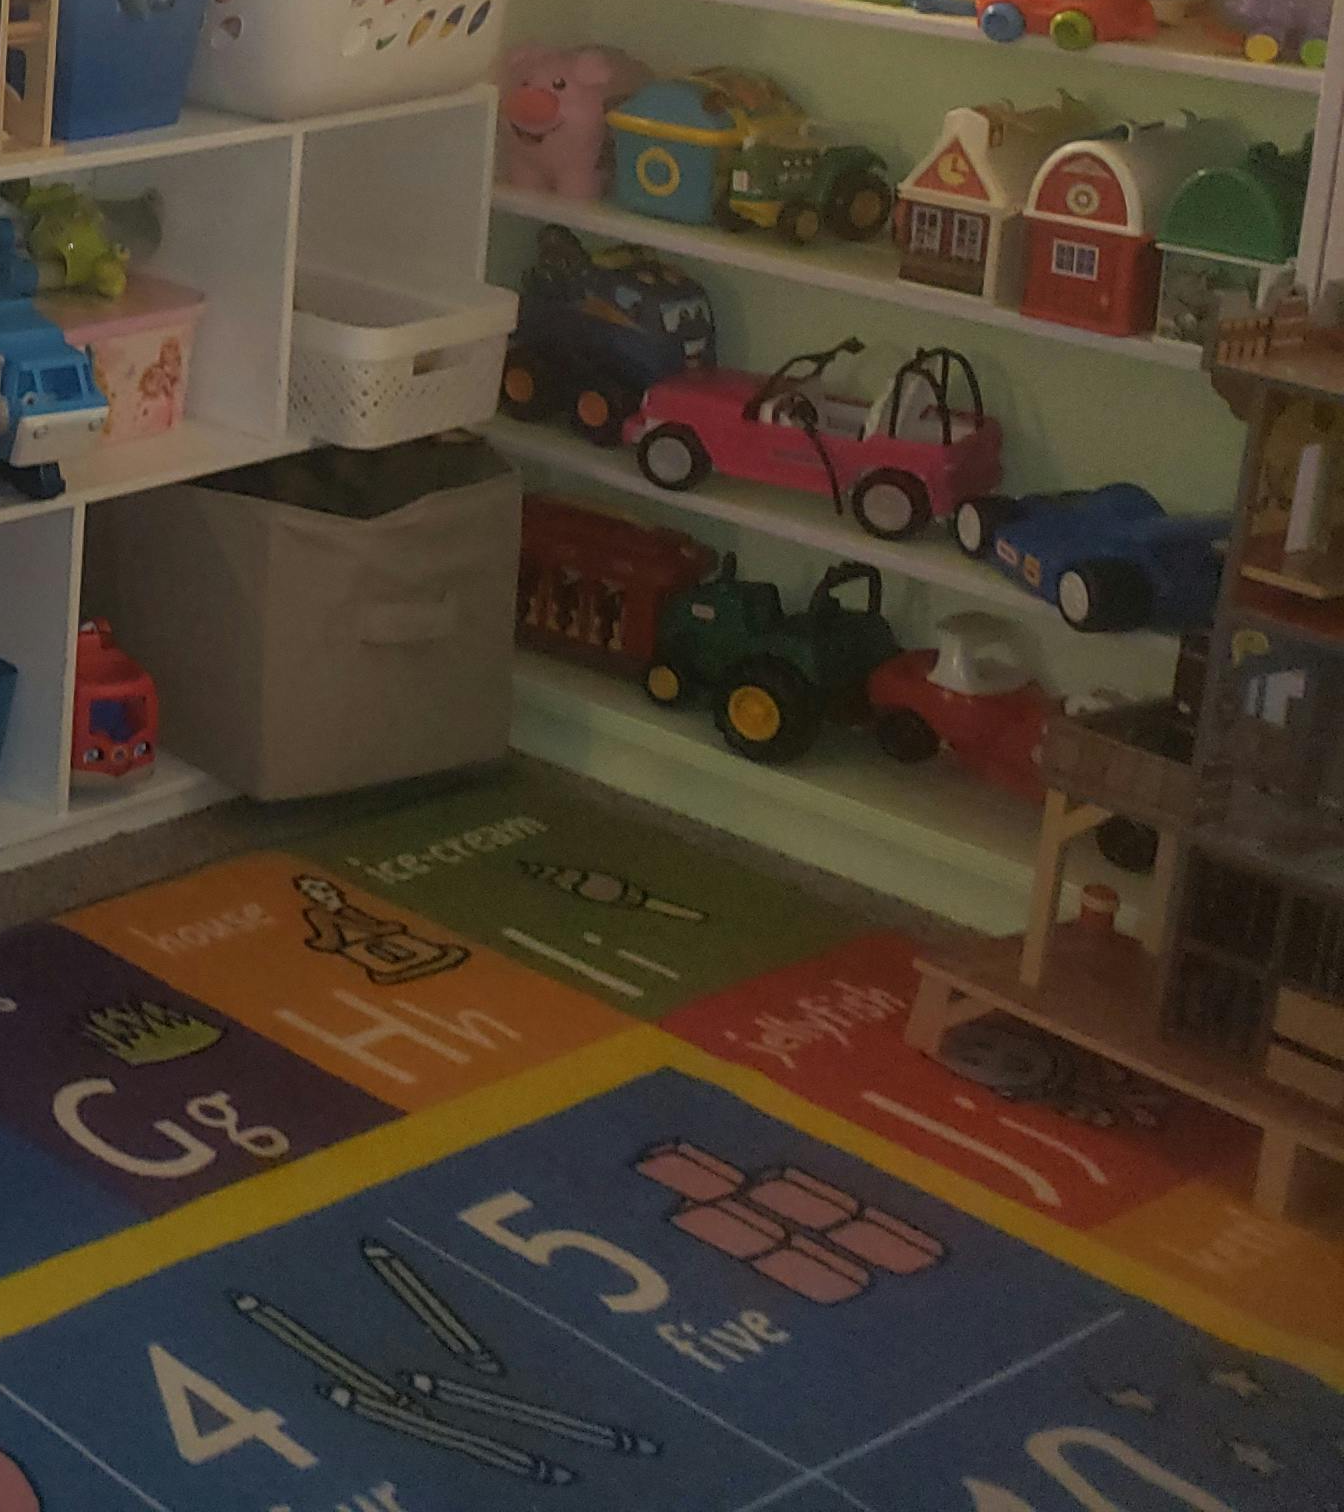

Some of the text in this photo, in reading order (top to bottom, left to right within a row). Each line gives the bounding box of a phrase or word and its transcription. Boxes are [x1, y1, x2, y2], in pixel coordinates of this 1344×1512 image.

[140, 900, 277, 956] house
[457, 1189, 671, 1313] 5
[656, 1306, 791, 1374] five
[147, 1342, 320, 1471] 4
